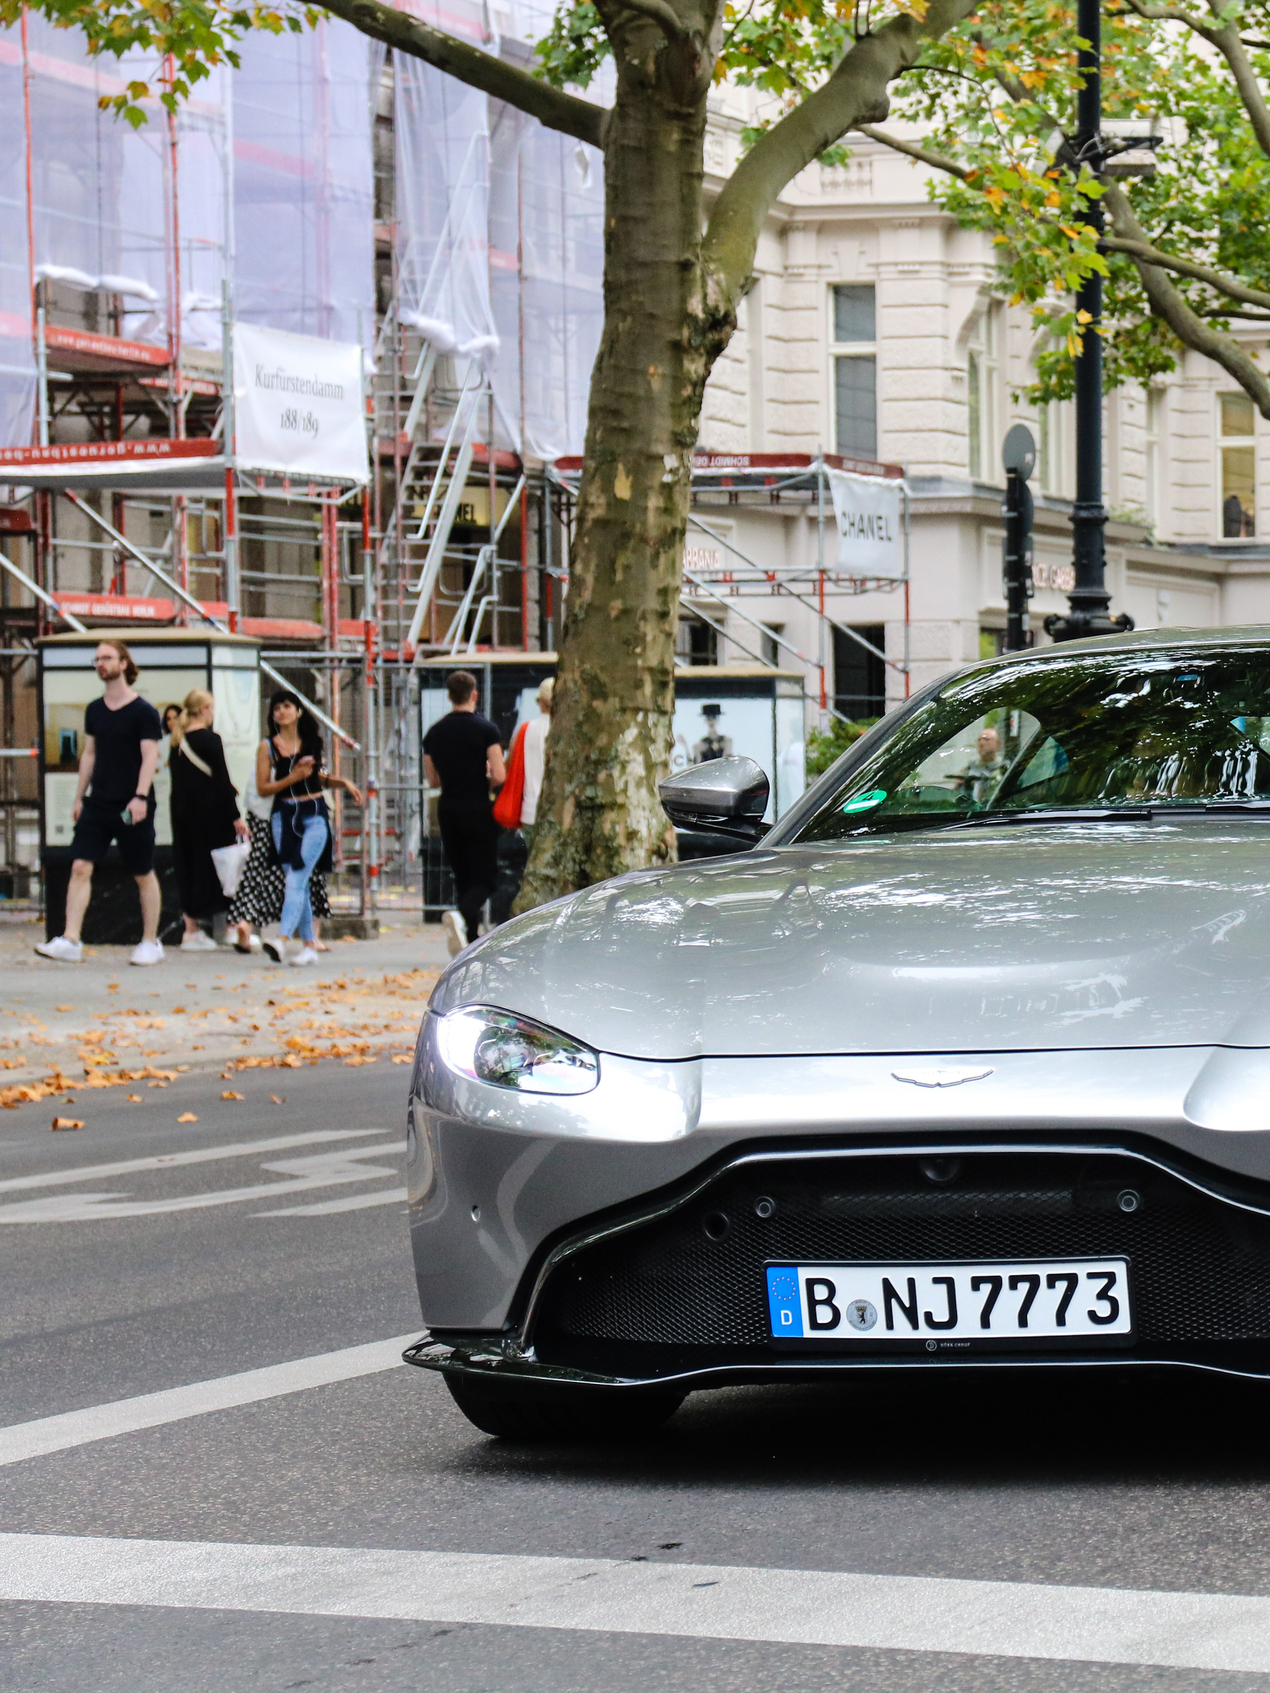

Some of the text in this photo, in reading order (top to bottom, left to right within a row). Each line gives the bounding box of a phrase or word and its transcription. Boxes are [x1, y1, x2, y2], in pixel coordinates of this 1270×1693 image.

[255, 364, 344, 400] Kurfürstendamm
[280, 407, 319, 440] 188/189
[0, 443, 171, 461] www.geruestbau-be
[840, 511, 892, 542] CHANEL
[780, 1310, 793, 1325] D
[806, 1278, 841, 1331] B
